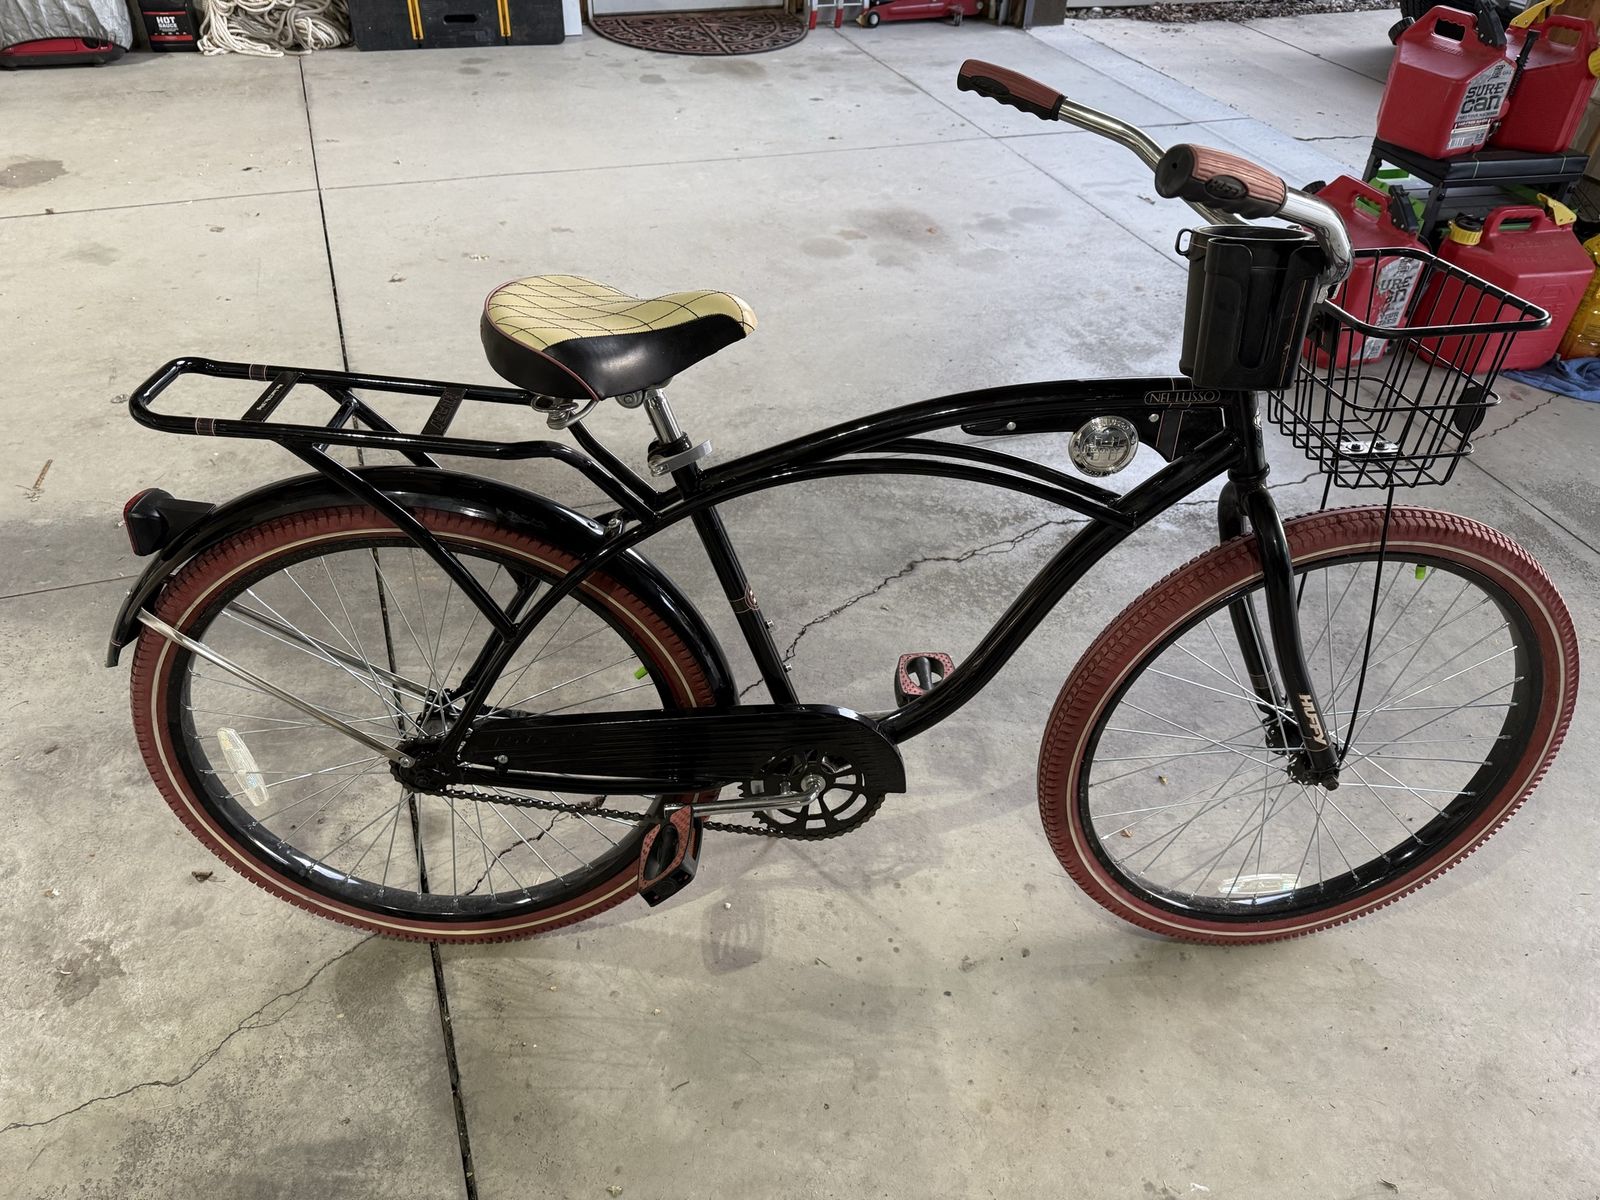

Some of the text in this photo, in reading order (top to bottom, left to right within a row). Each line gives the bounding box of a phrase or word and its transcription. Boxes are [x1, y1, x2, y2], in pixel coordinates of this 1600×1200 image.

[156, 16, 175, 24] HOT
[1465, 82, 1507, 99] SURE
[1380, 277, 1412, 291] URE
[1149, 391, 1215, 403] NEL LUSSO
[1299, 694, 1328, 746] HUFFY
